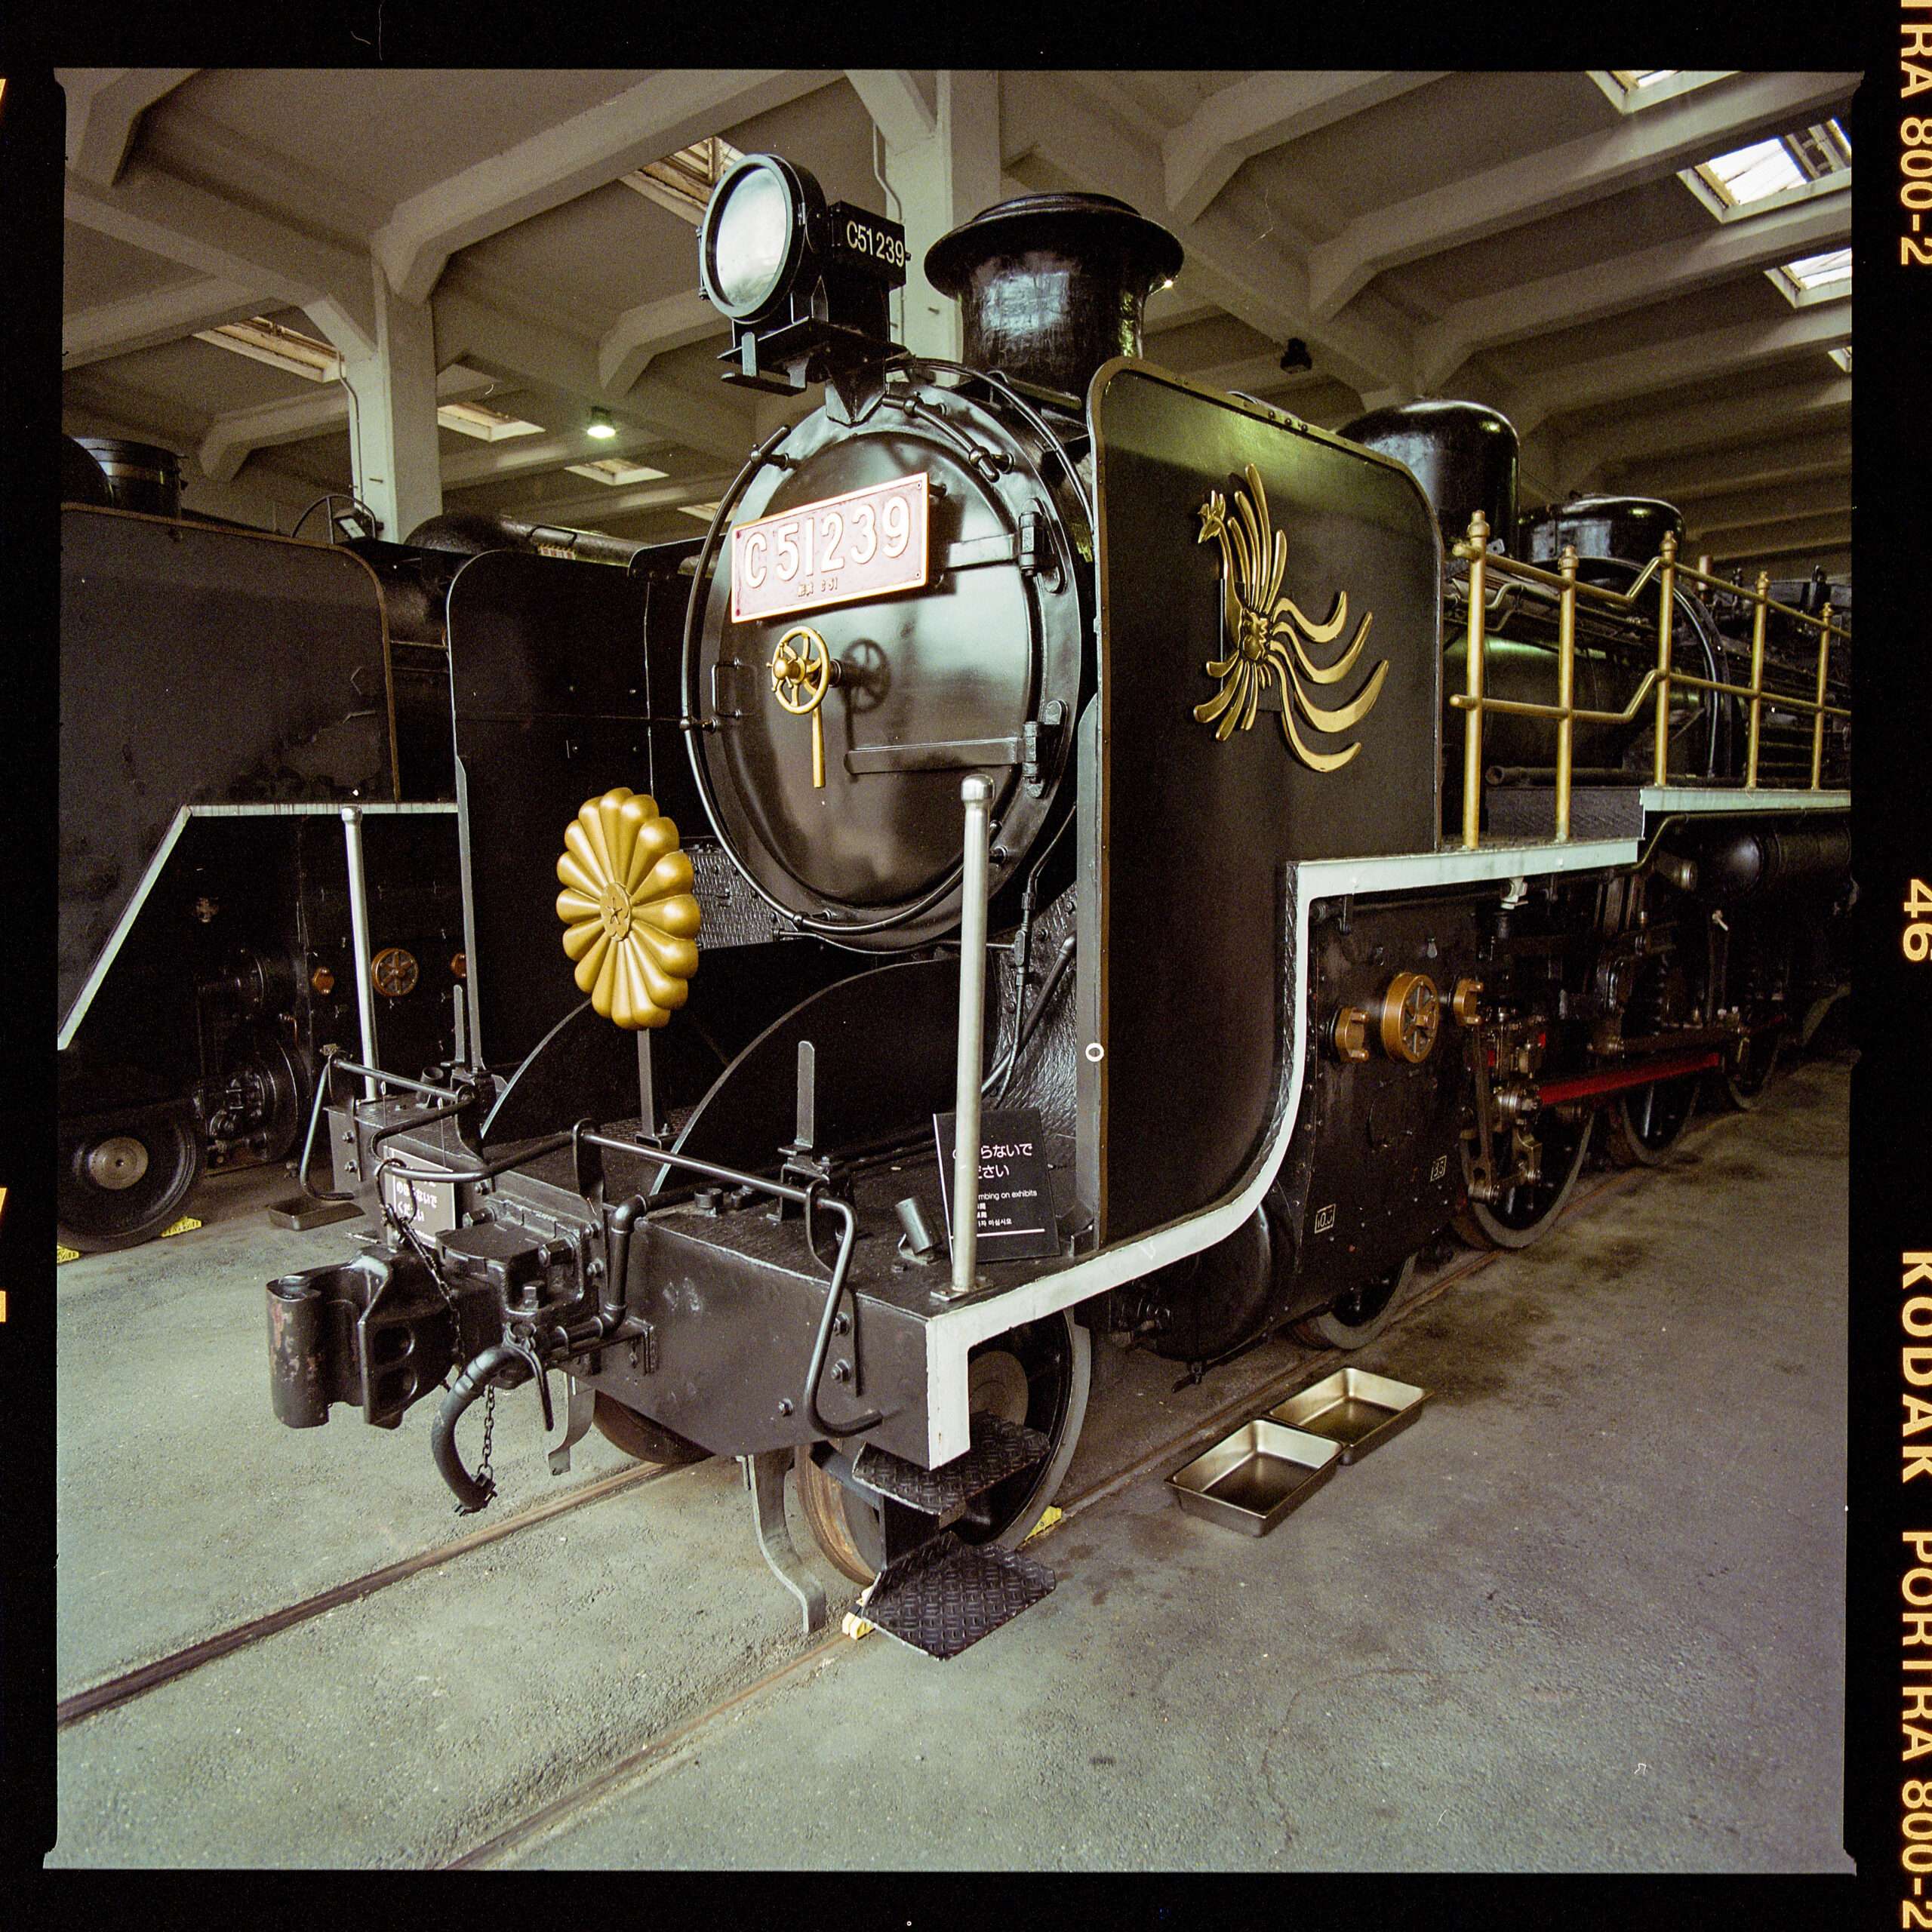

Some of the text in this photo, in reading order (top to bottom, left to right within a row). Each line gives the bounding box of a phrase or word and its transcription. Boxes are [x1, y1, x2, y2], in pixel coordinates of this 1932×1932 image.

[1900, 116, 1932, 266] 800-2
[846, 220, 904, 267] C51239
[743, 495, 911, 589] C51239
[1902, 878, 1932, 962] 46
[395, 1180, 438, 1208] のぼないで
[978, 1192, 1000, 1201] mbing
[1011, 1189, 1038, 1198] exhibits
[1901, 1251, 1932, 1484] KODAK
[1901, 1779, 1932, 1930] 800-2
